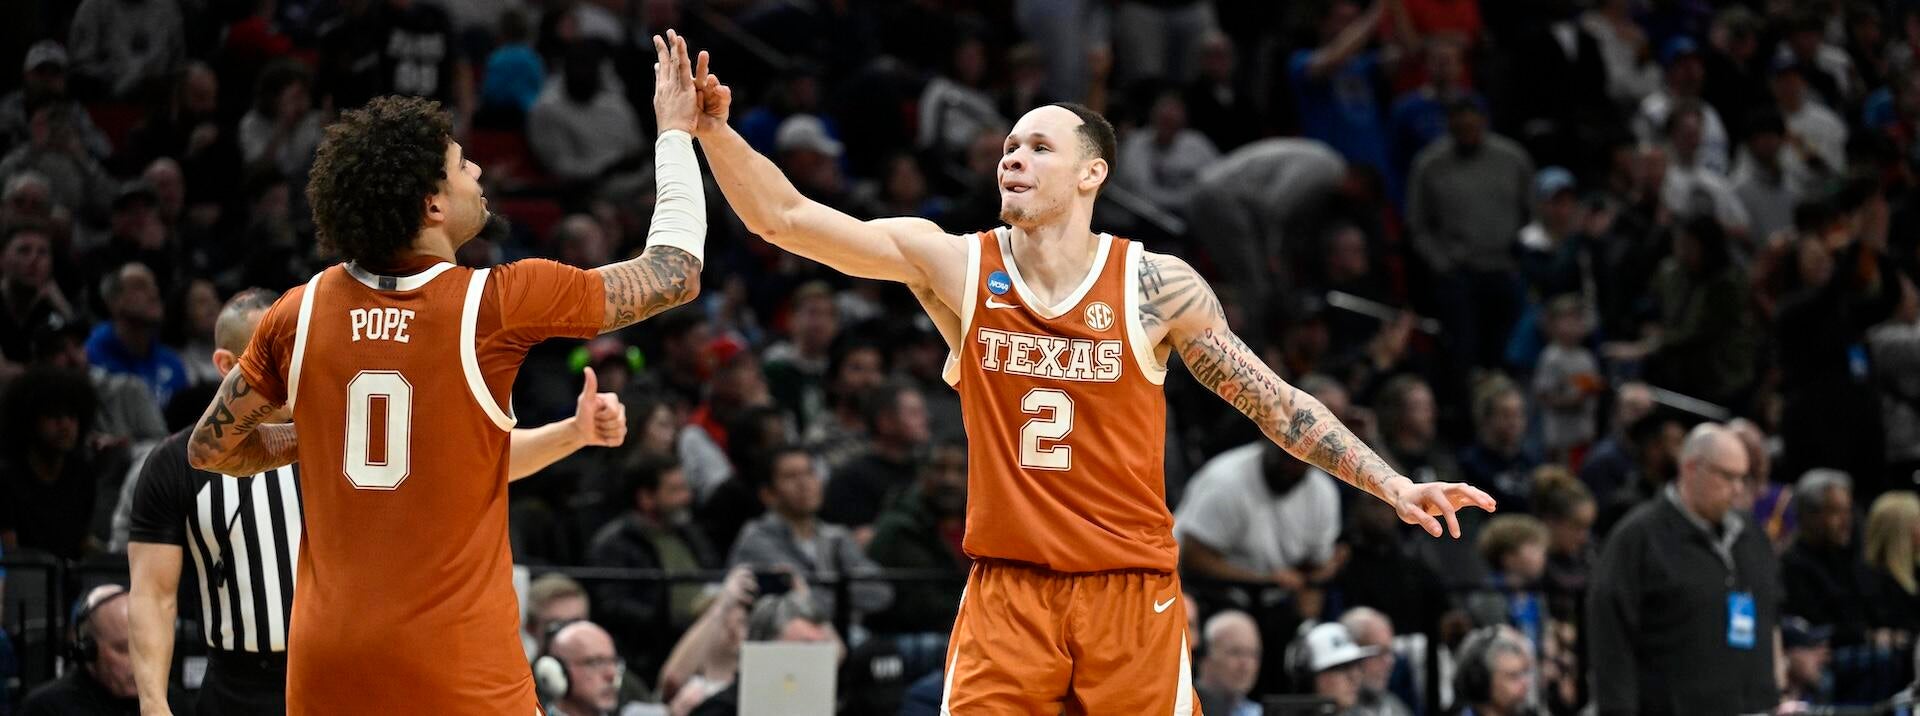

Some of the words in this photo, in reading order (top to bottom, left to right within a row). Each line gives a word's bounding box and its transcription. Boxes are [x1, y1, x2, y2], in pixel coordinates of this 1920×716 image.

[989, 279, 1010, 291] NCAA
[349, 307, 416, 344] POPE
[1086, 302, 1114, 329] SEC
[977, 326, 1124, 383] TEXAS
[342, 369, 414, 491] 0
[1018, 387, 1075, 471] 2
